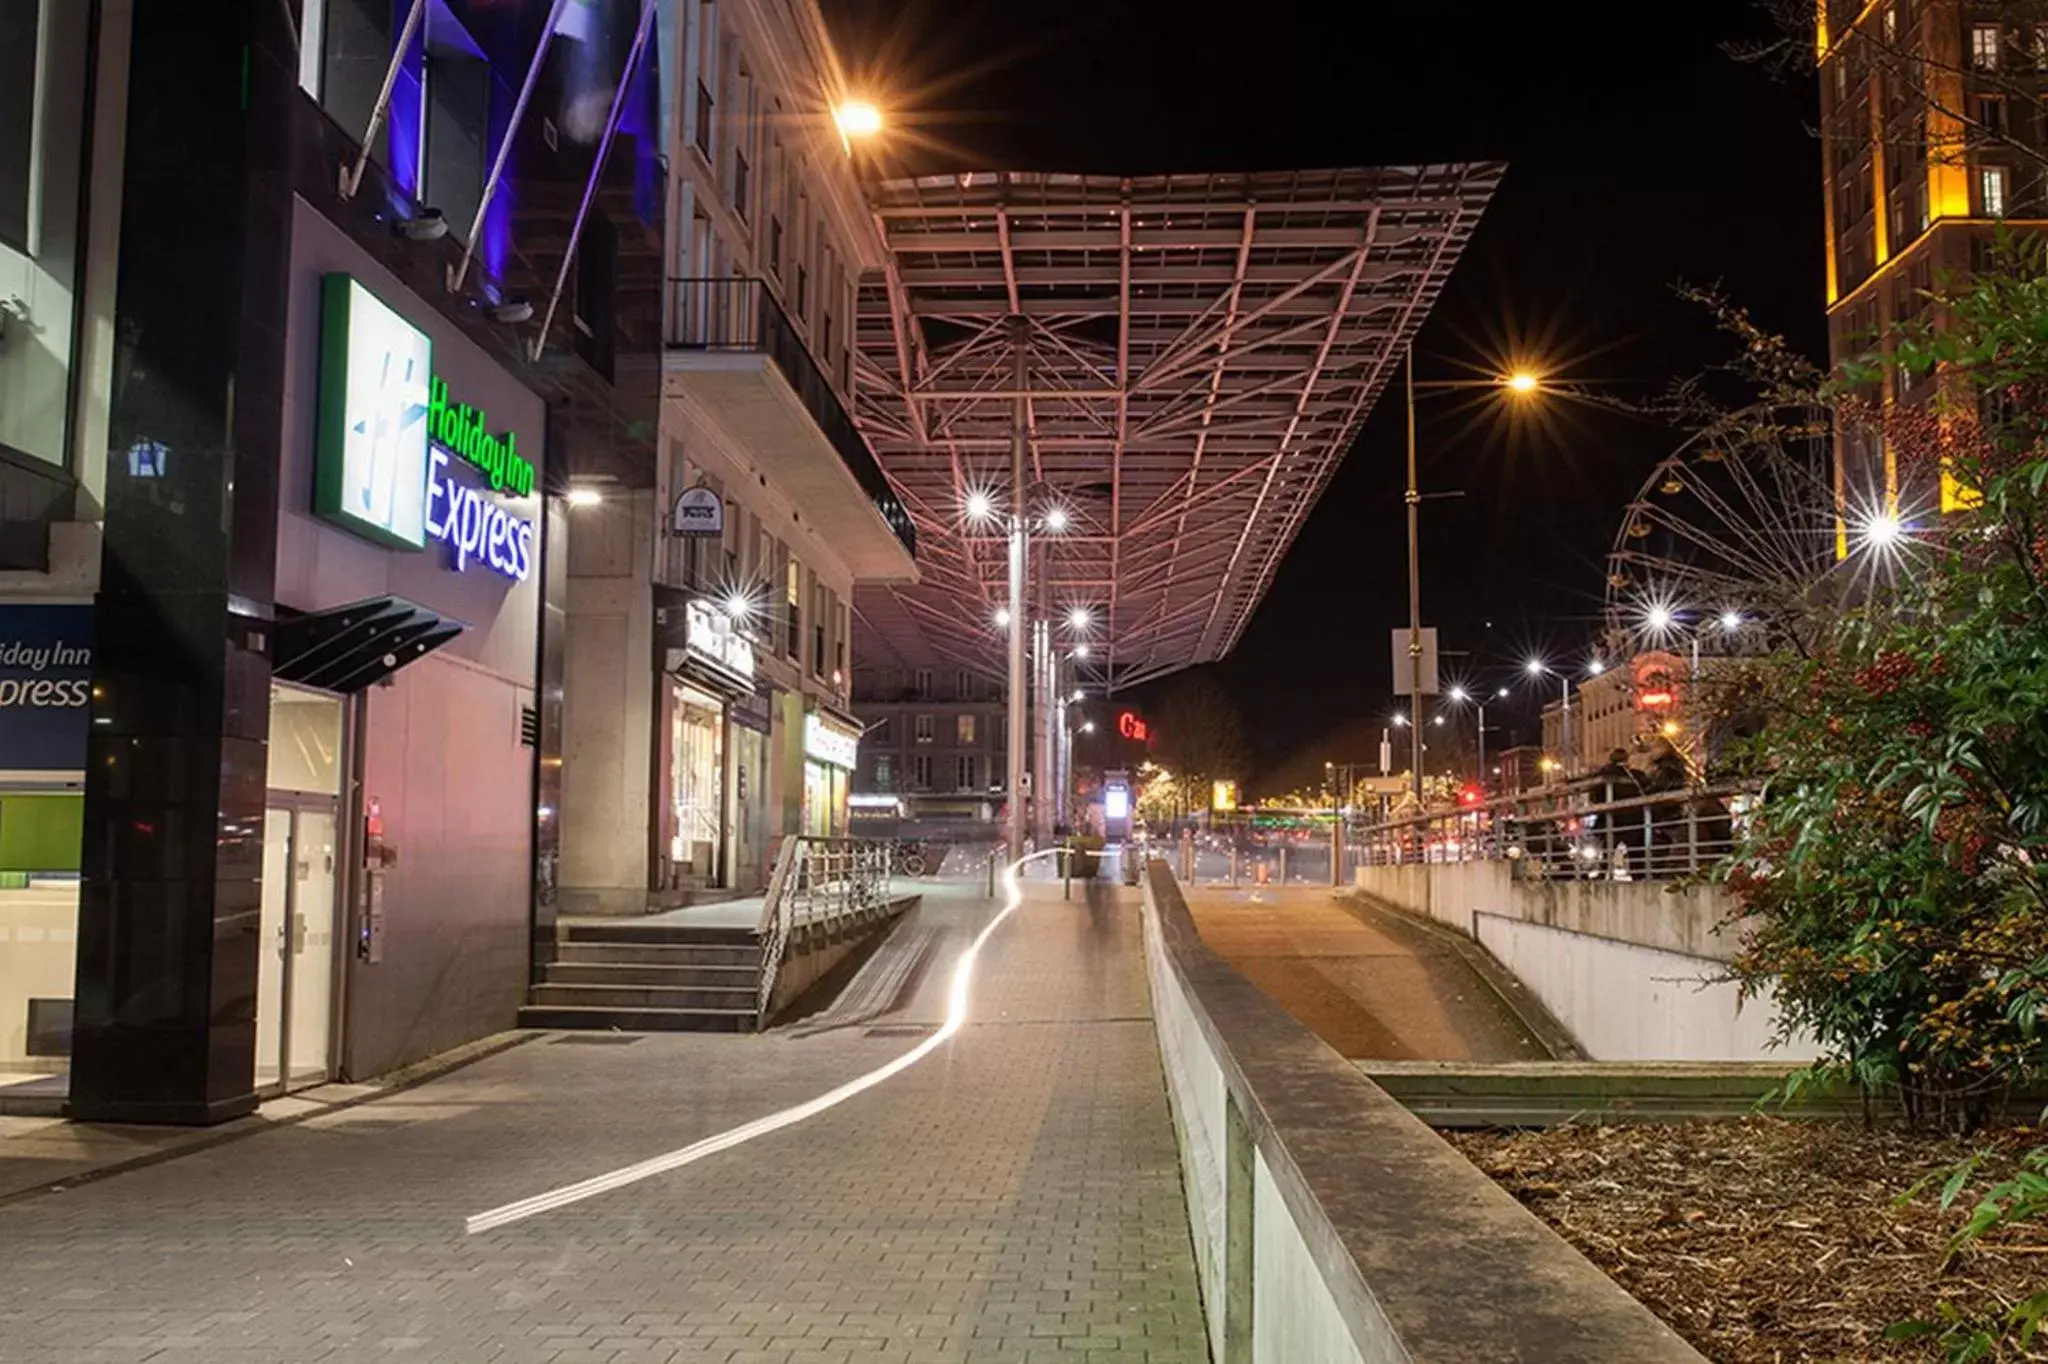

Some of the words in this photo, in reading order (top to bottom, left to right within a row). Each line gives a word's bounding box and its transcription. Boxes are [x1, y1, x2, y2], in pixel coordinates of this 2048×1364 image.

[428, 375, 506, 490] Holiday
[505, 431, 535, 497] Inn
[425, 446, 535, 581] Express
[52, 640, 91, 665] Inn
